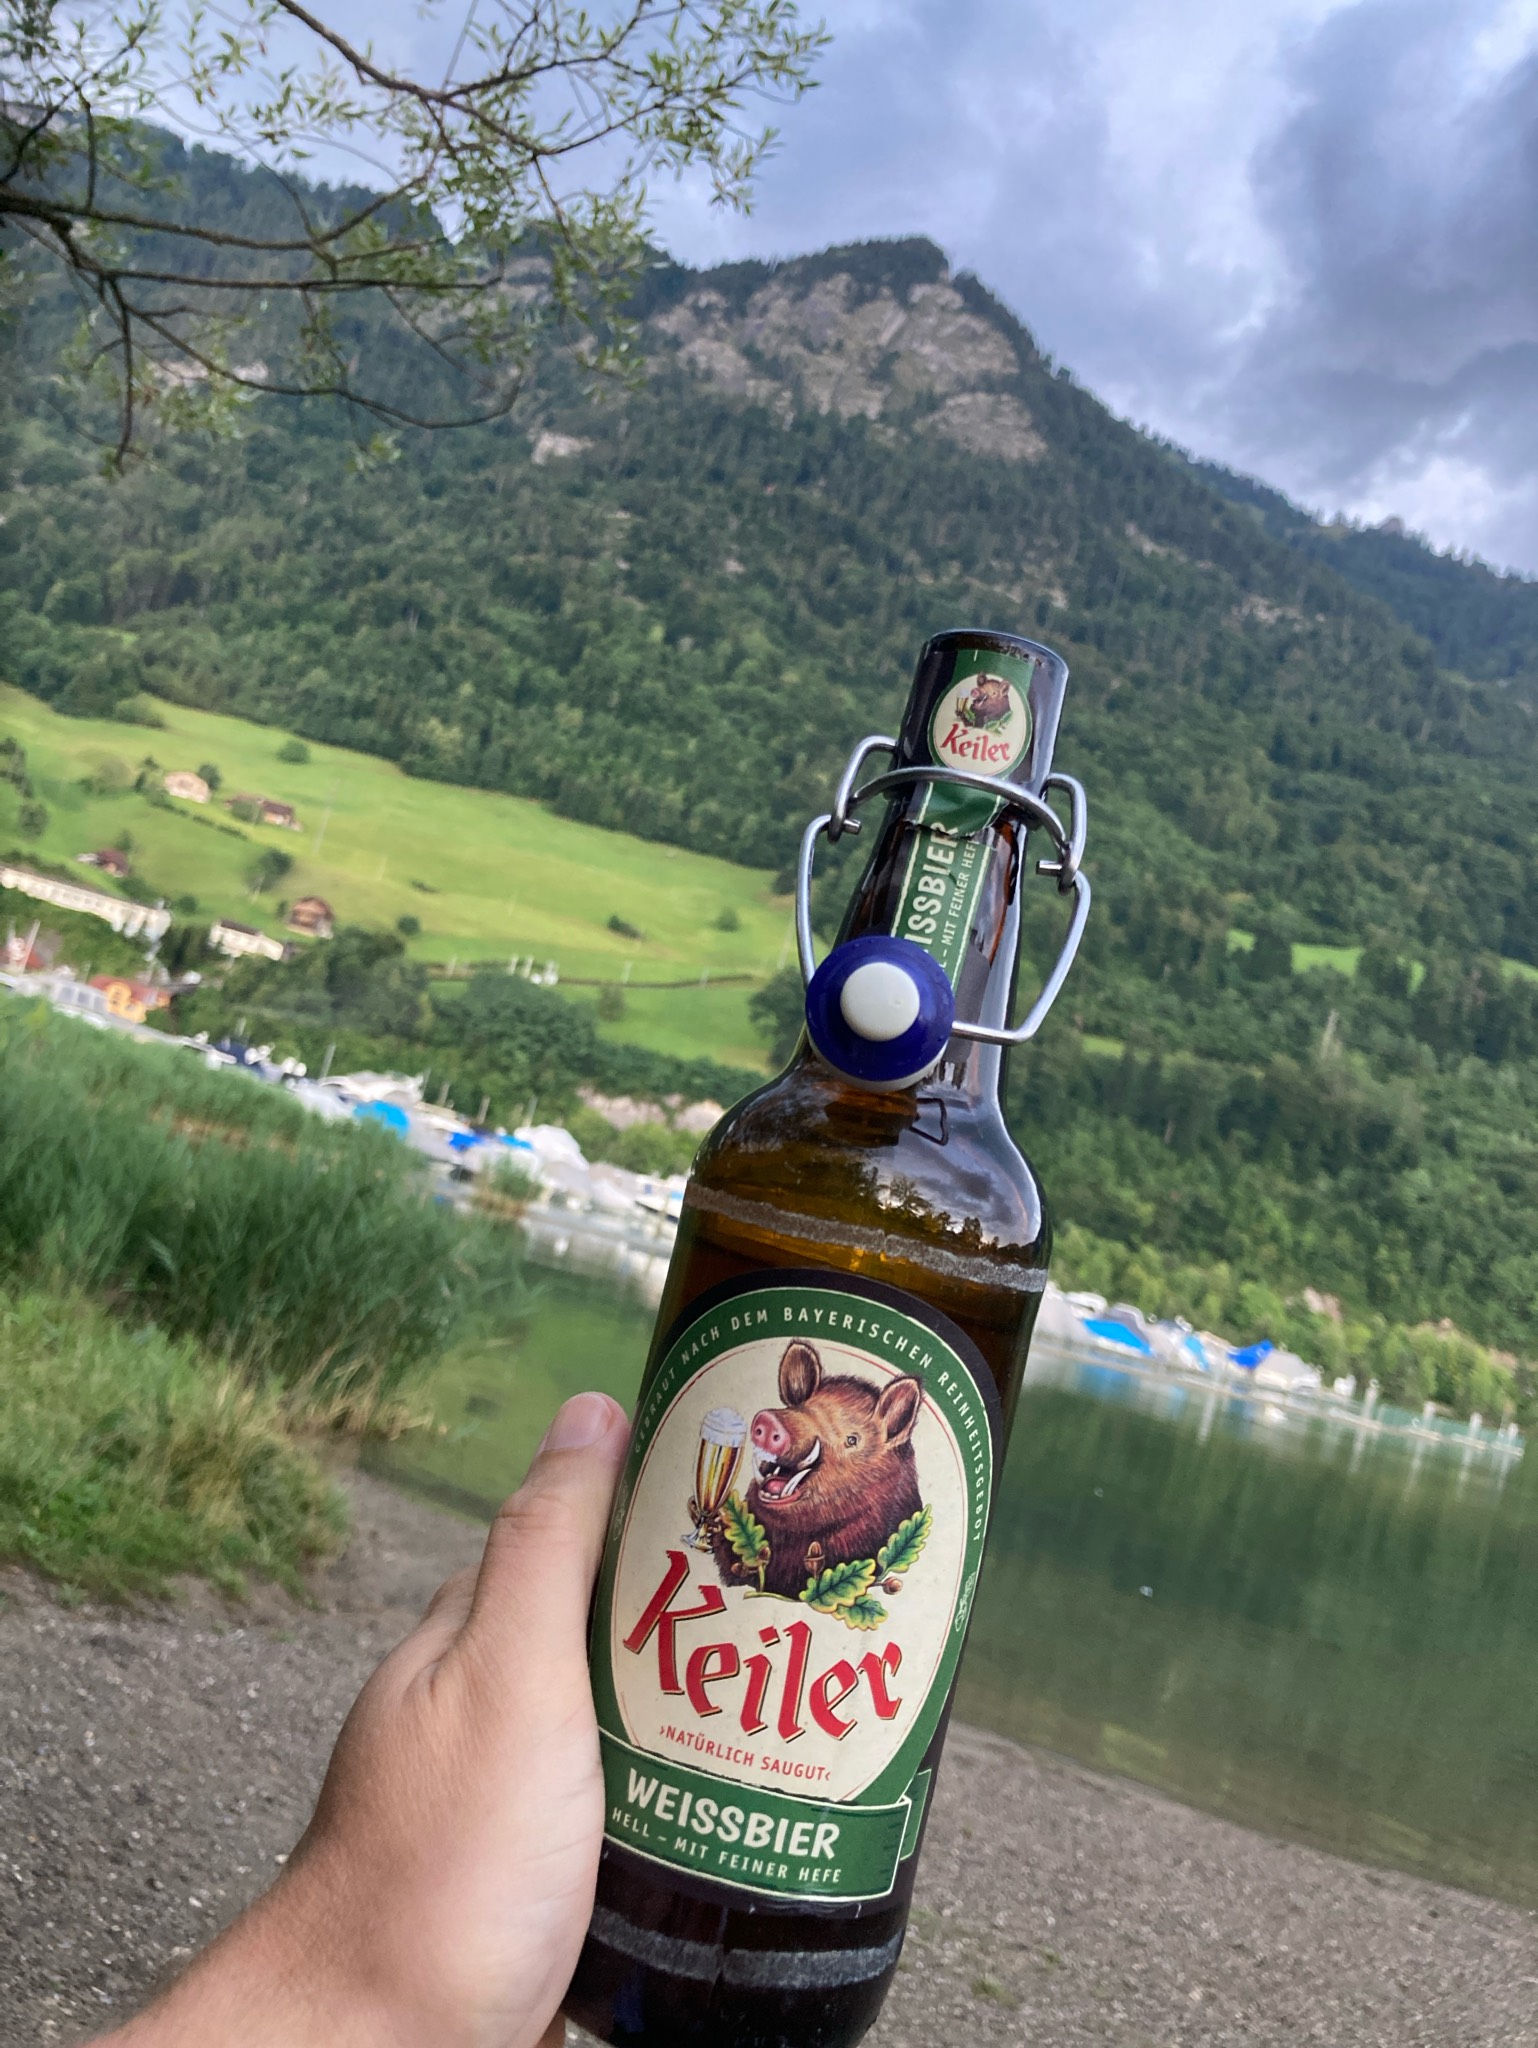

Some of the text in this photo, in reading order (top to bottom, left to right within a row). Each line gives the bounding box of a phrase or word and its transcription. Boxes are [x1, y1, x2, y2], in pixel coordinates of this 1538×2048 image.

[940, 723, 1010, 762] Keiler
[904, 821, 958, 947] ISSBIER
[941, 921, 956, 945] MIT
[949, 871, 970, 918] FEINER
[681, 1326, 720, 1365] NACH
[731, 1309, 768, 1330] DEM
[783, 1307, 933, 1369] BAYERISCHEN
[937, 1372, 985, 1541] REINHEITSGEBOT
[623, 1550, 903, 1743] Keiler
[612, 1806, 650, 1838] HELL
[674, 1836, 710, 1859] MIT
[718, 1851, 788, 1879] FEINER
[799, 1867, 842, 1883] HEFE
[627, 1767, 840, 1860] WEISSBIER
